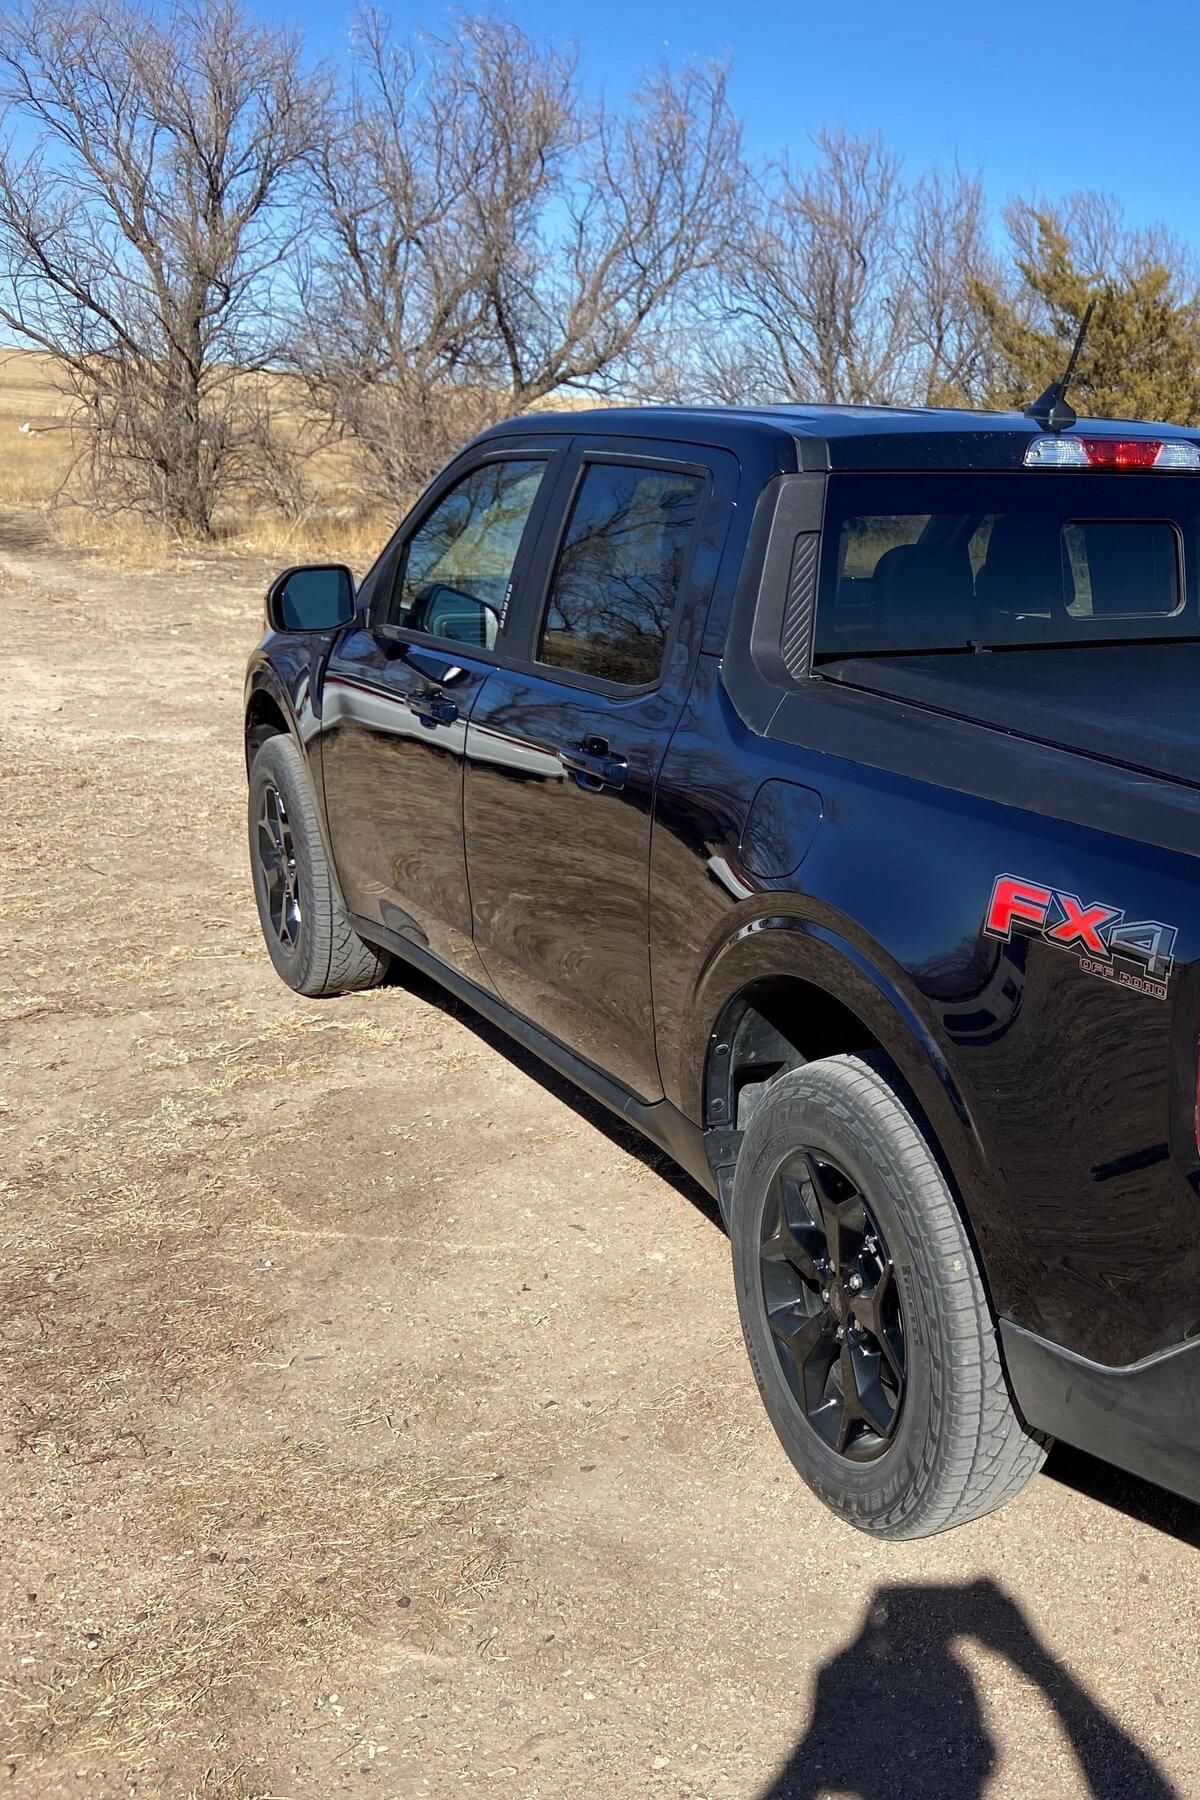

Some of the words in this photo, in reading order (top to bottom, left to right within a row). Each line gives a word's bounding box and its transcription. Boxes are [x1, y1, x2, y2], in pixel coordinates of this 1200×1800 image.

[983, 873, 1178, 984] FX4
[1080, 957, 1114, 977] OFF
[1119, 971, 1167, 998] ROAD
[838, 1459, 910, 1511] PIRELLI
